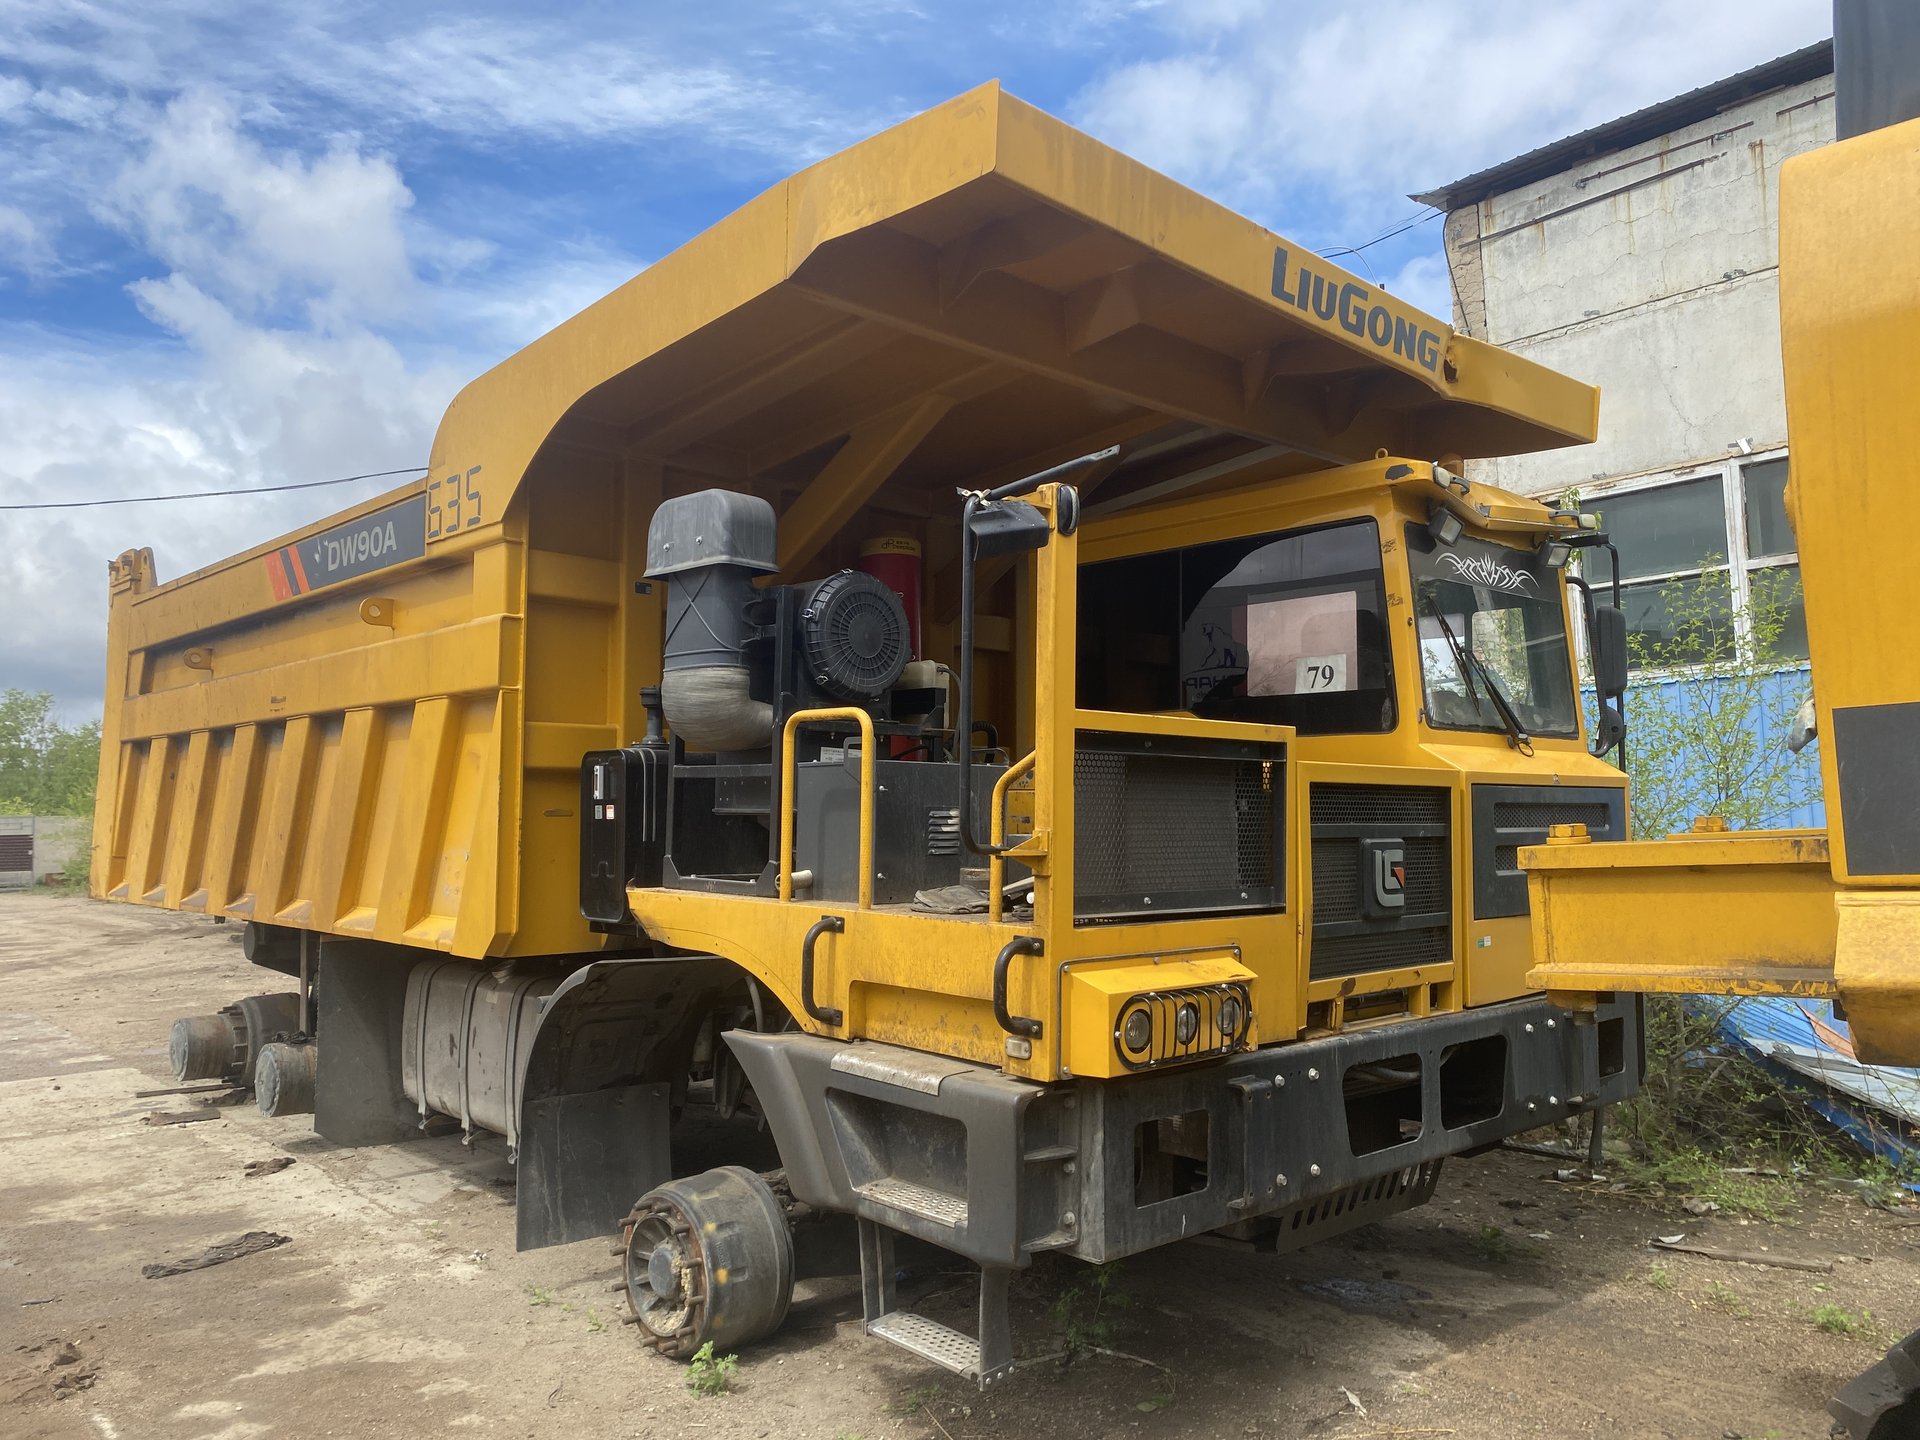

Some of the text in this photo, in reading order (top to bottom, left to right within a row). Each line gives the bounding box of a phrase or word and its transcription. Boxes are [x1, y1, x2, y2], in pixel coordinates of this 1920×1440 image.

[428, 465, 482, 539] 635
[327, 521, 397, 571] DW90A
[1307, 665, 1335, 689] 79
